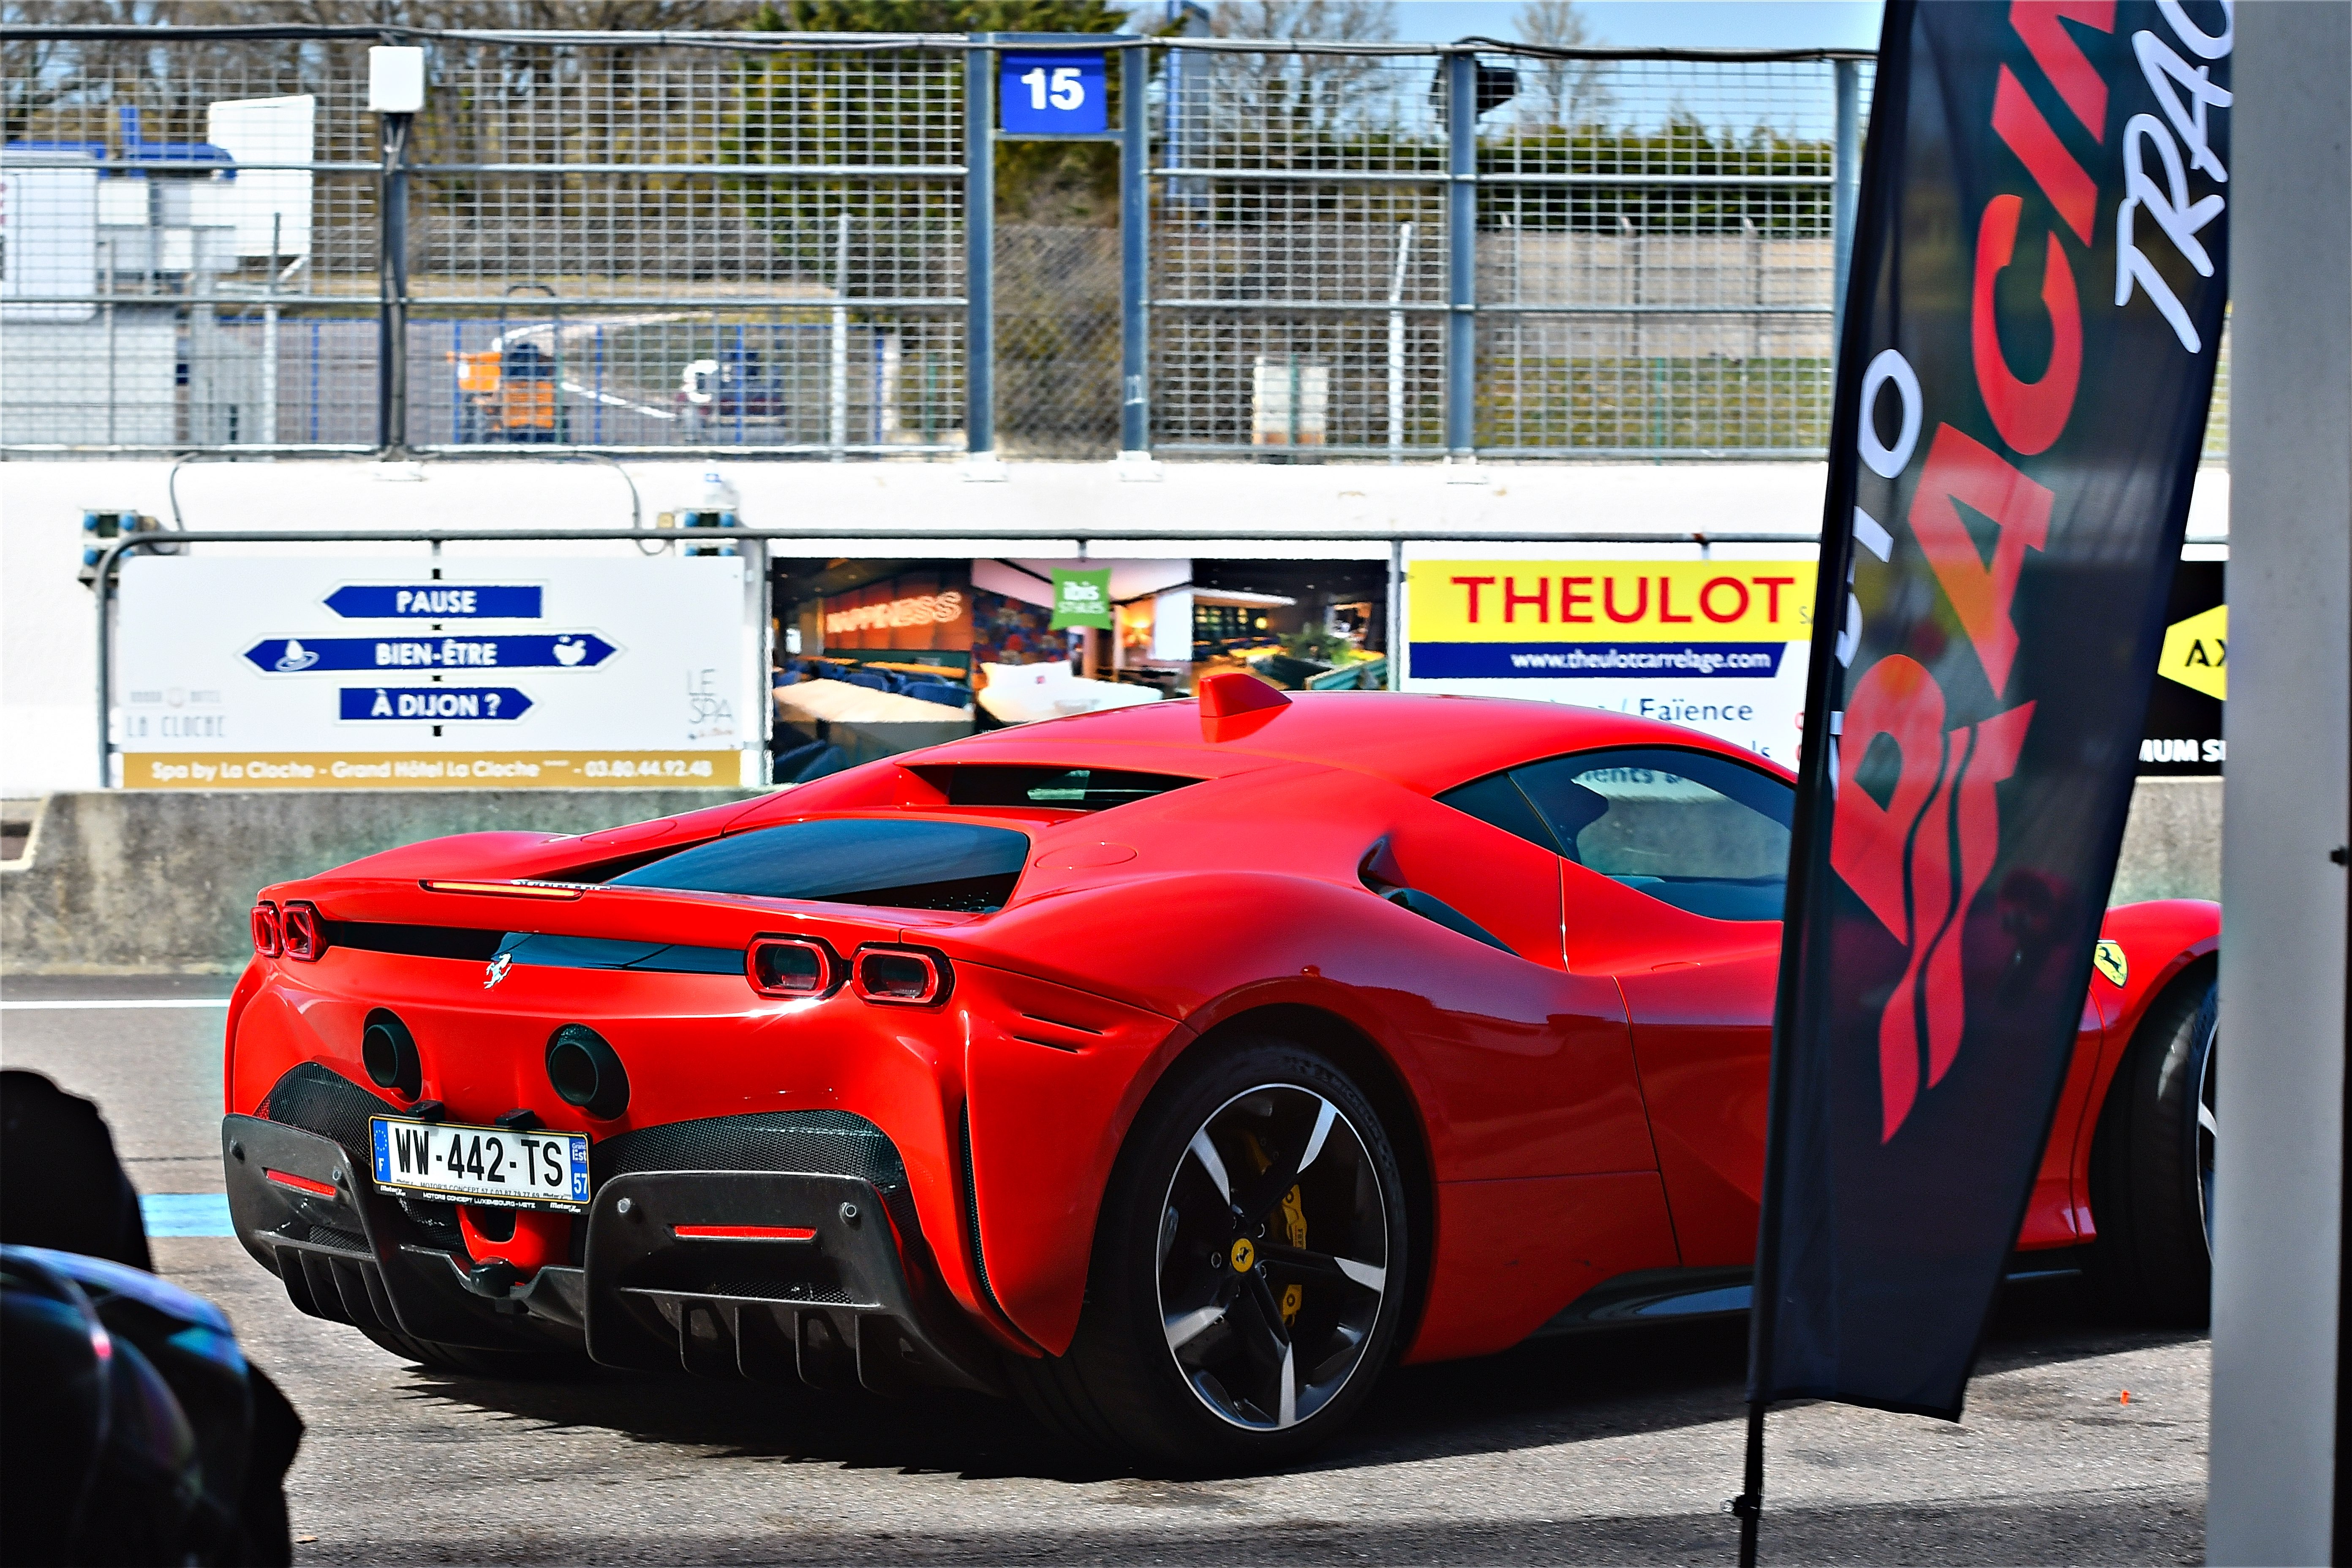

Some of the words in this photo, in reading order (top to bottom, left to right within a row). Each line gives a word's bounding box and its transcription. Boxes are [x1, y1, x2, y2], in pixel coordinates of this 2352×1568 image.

[1021, 67, 1085, 110] 15
[396, 590, 477, 613] PAUSE
[1450, 575, 1795, 624] THEULOT
[375, 638, 498, 666] BIEN-ÊTRE
[1510, 648, 1771, 674] www.theulotcarrelage.com
[371, 689, 393, 717] À
[398, 694, 479, 717] DIJON
[484, 693, 502, 717] ?
[1639, 698, 1753, 721] Faïence
[152, 761, 189, 781] Spa
[192, 761, 218, 781] by
[220, 761, 243, 779] La
[246, 761, 316, 779] Cloche
[331, 760, 391, 778] Grand
[446, 760, 470, 777] La
[472, 760, 540, 777] Cloche
[378, 1157, 384, 1172] F
[395, 1127, 563, 1187] WW-442-TS
[572, 1149, 586, 1161] Est
[574, 1173, 588, 1195] 57
